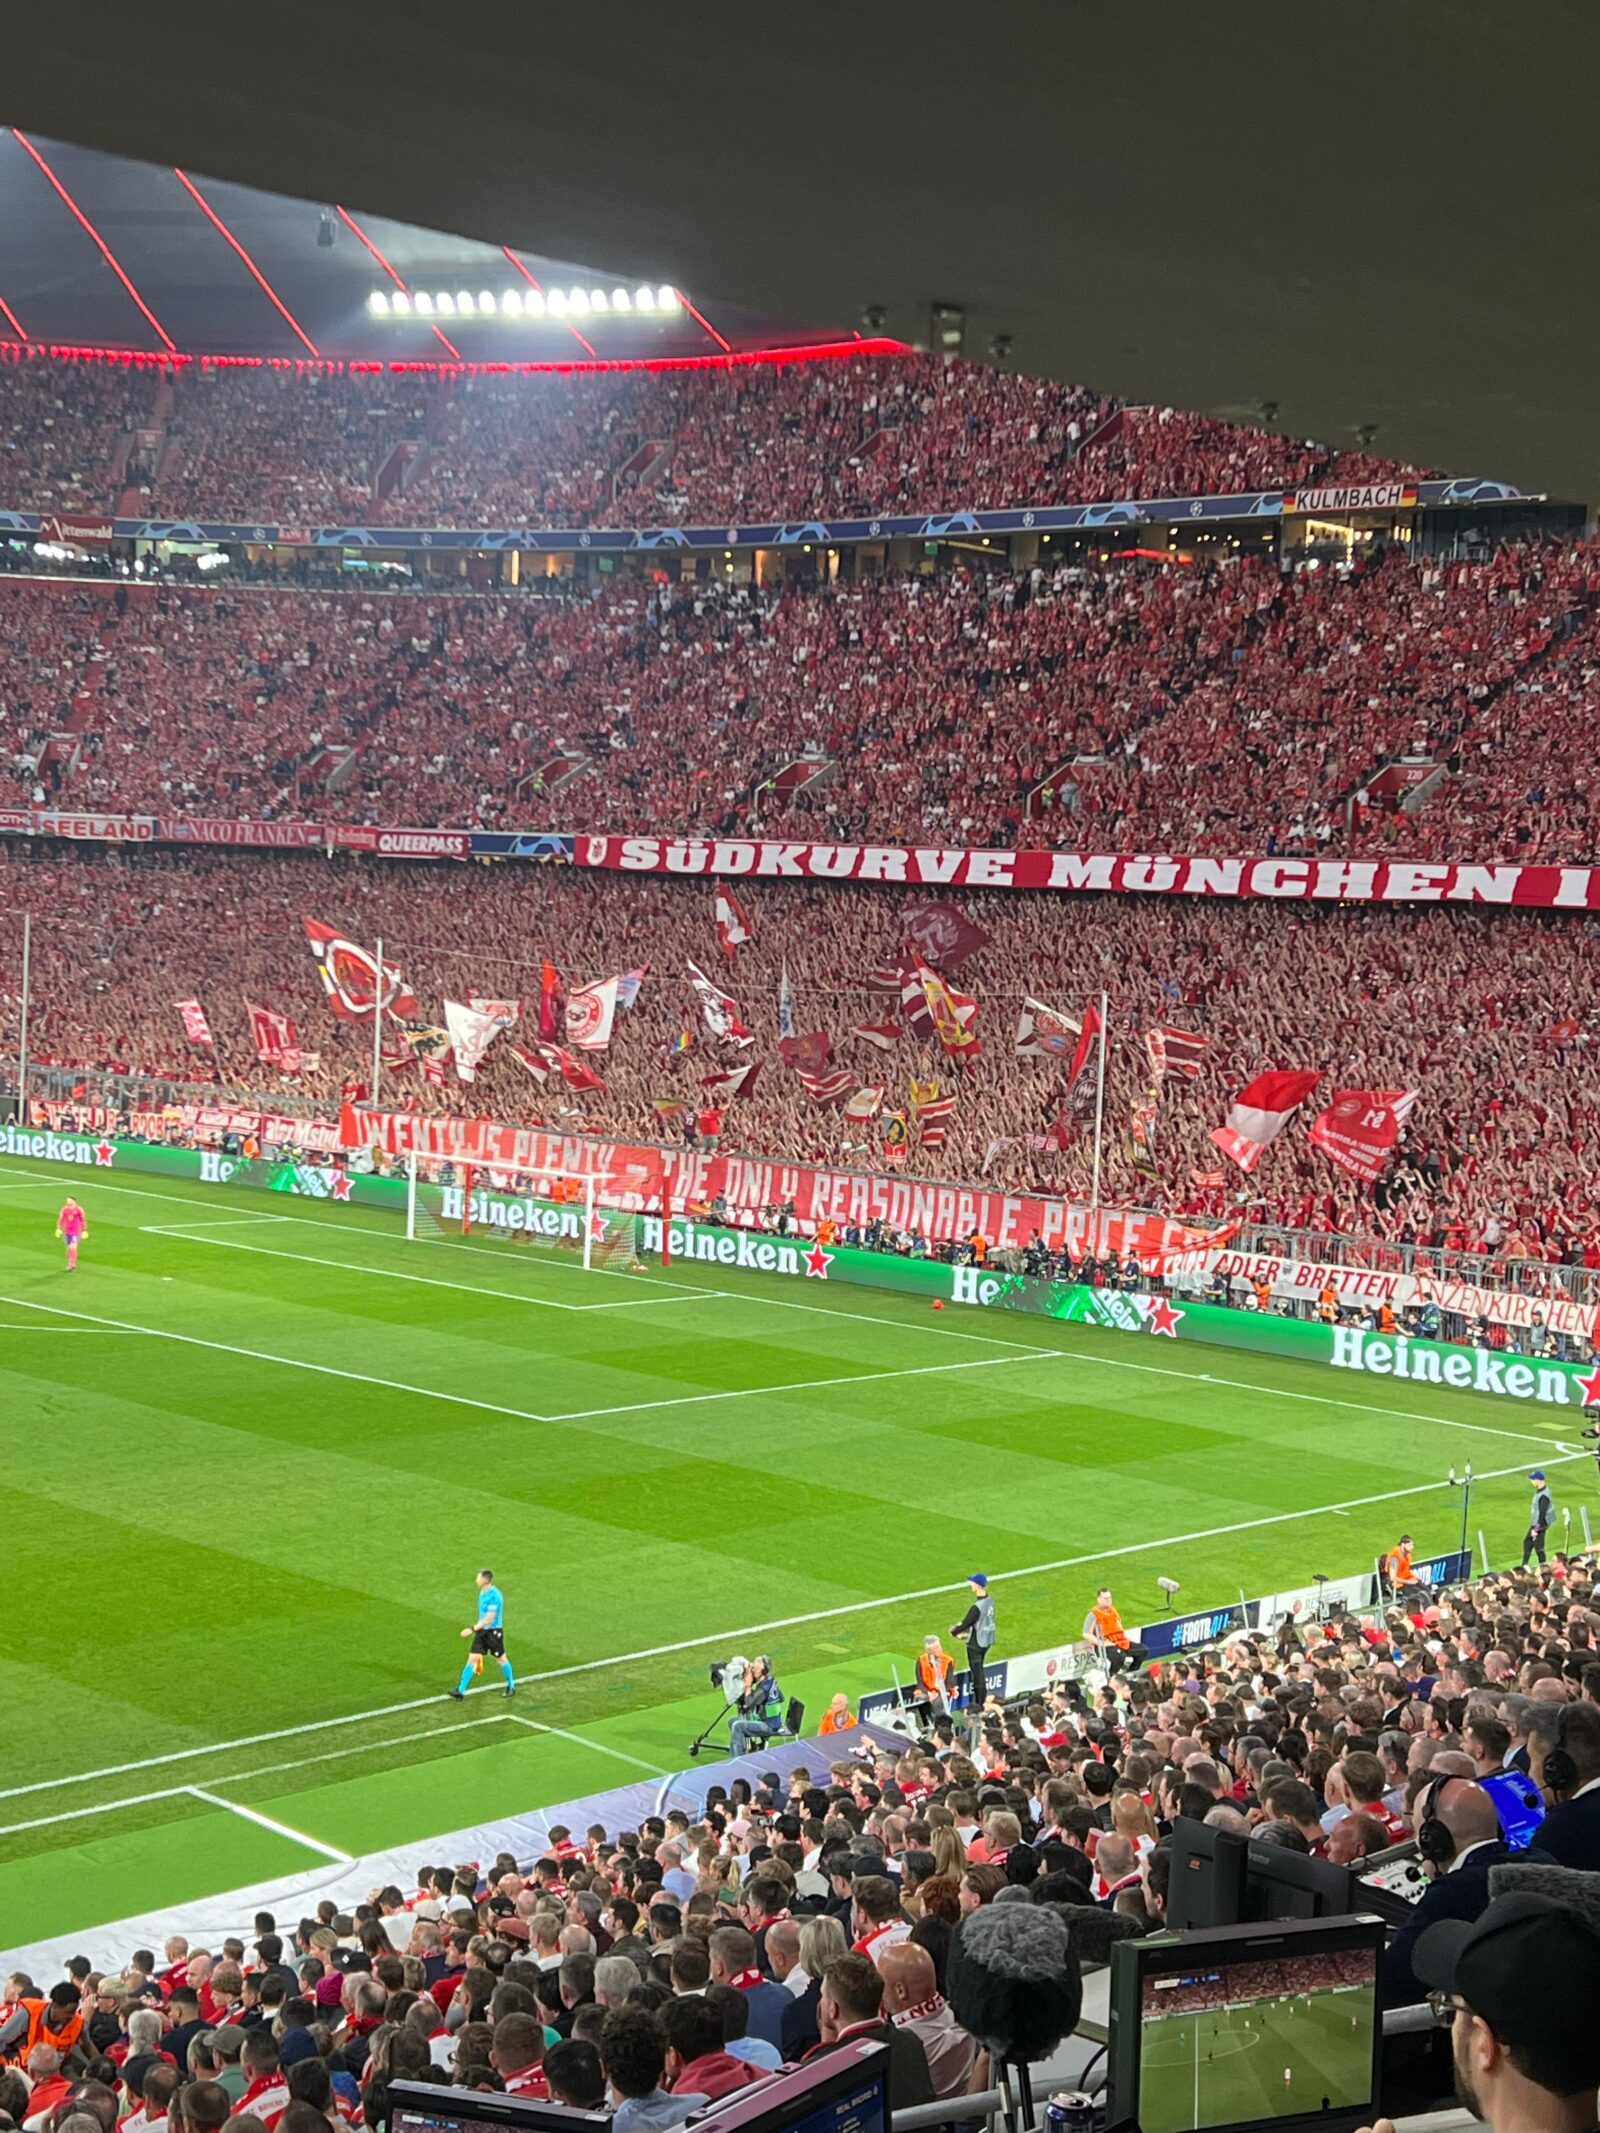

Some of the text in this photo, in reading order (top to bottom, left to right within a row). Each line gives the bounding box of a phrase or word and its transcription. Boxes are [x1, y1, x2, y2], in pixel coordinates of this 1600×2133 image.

[1296, 485, 1401, 511] KULMBACH
[42, 819, 151, 839] SEELAND
[379, 834, 464, 853] QUEERPASS
[619, 839, 1016, 886] SÜDKURVE
[1047, 853, 1522, 902] MÜNCHEN
[0, 1126, 92, 1165] eineken
[441, 1186, 580, 1239] Heineken
[809, 1173, 1022, 1247] REASONABLE
[643, 1216, 799, 1275] Heineken
[1211, 1252, 1595, 1333] ADLER BRETTEN ANZENKIRCHEN
[1330, 1325, 1571, 1405] Heineken
